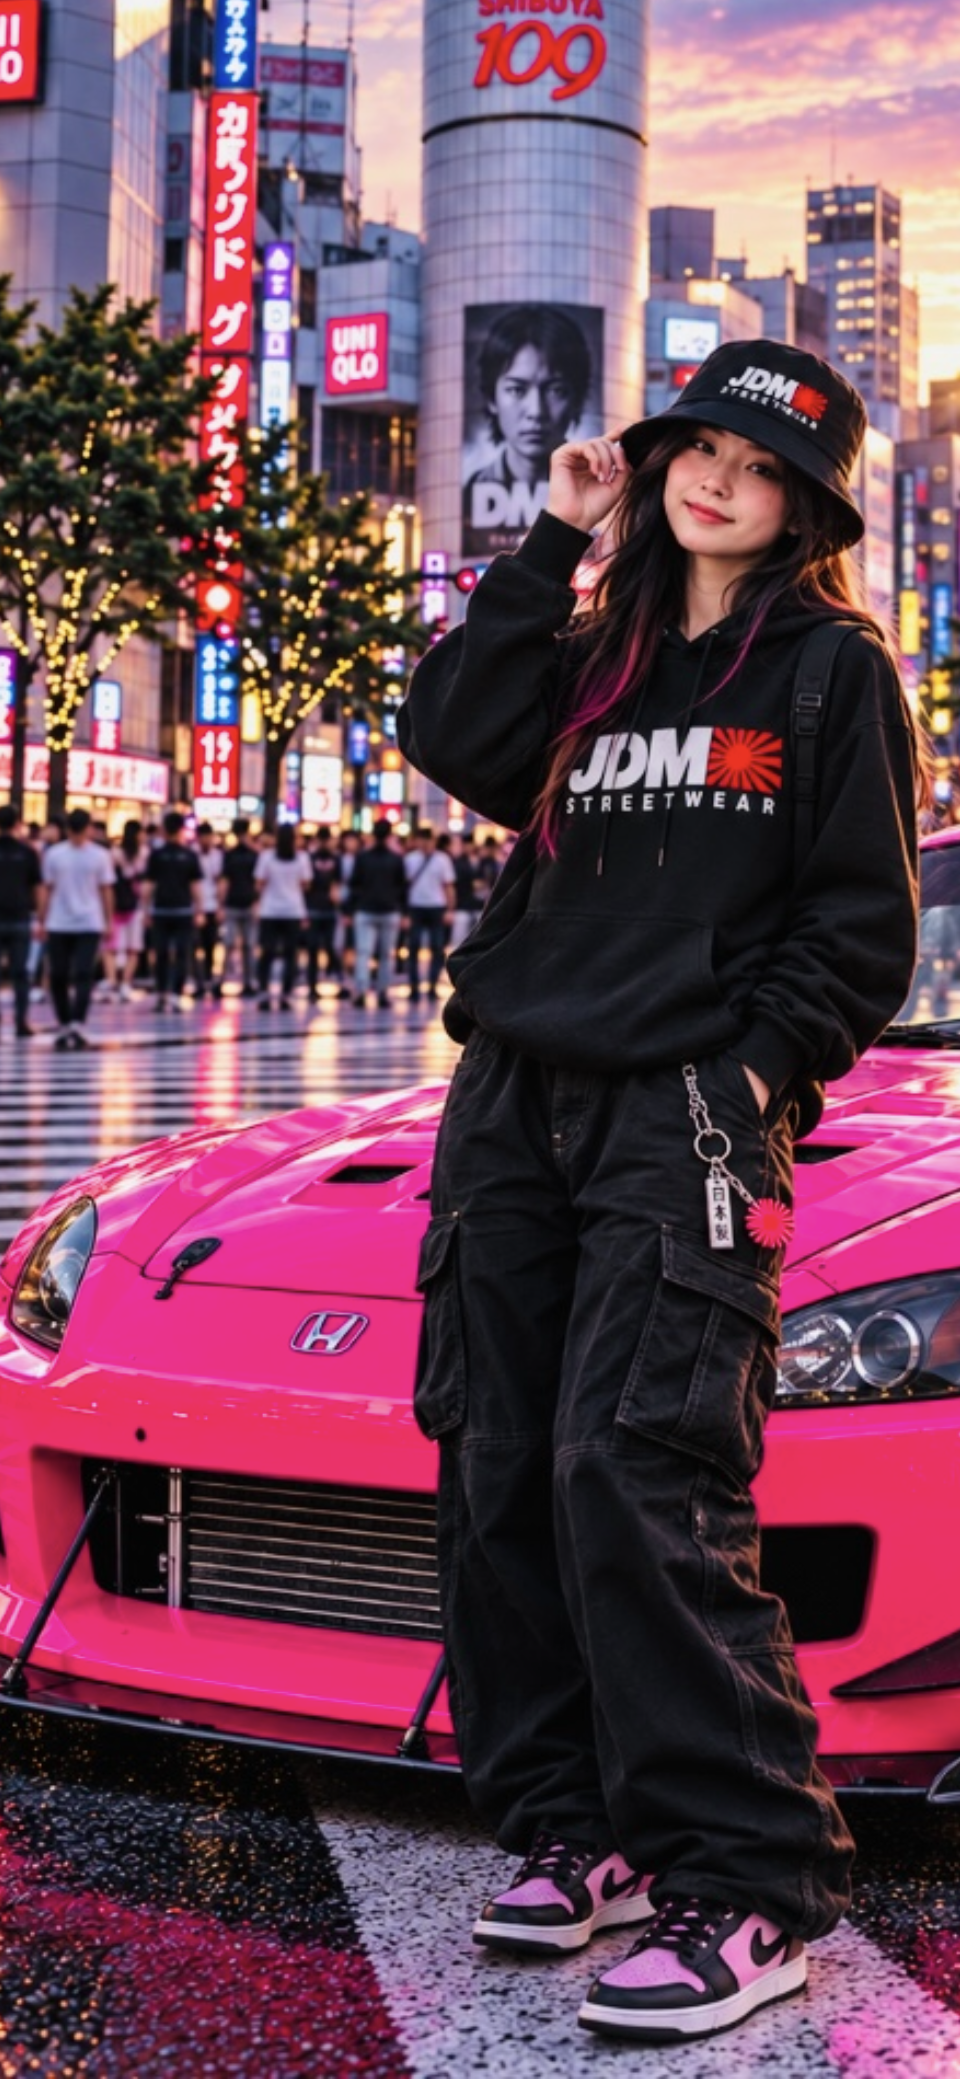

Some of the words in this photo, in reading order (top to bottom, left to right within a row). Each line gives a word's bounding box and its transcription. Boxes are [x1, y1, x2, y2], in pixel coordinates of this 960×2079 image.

[473, 19, 607, 101] 109
[332, 323, 377, 354] UNI
[331, 351, 379, 385] QLO
[729, 366, 799, 404] JDM
[568, 726, 713, 794] JDM
[566, 791, 776, 815] STREETWEAR
